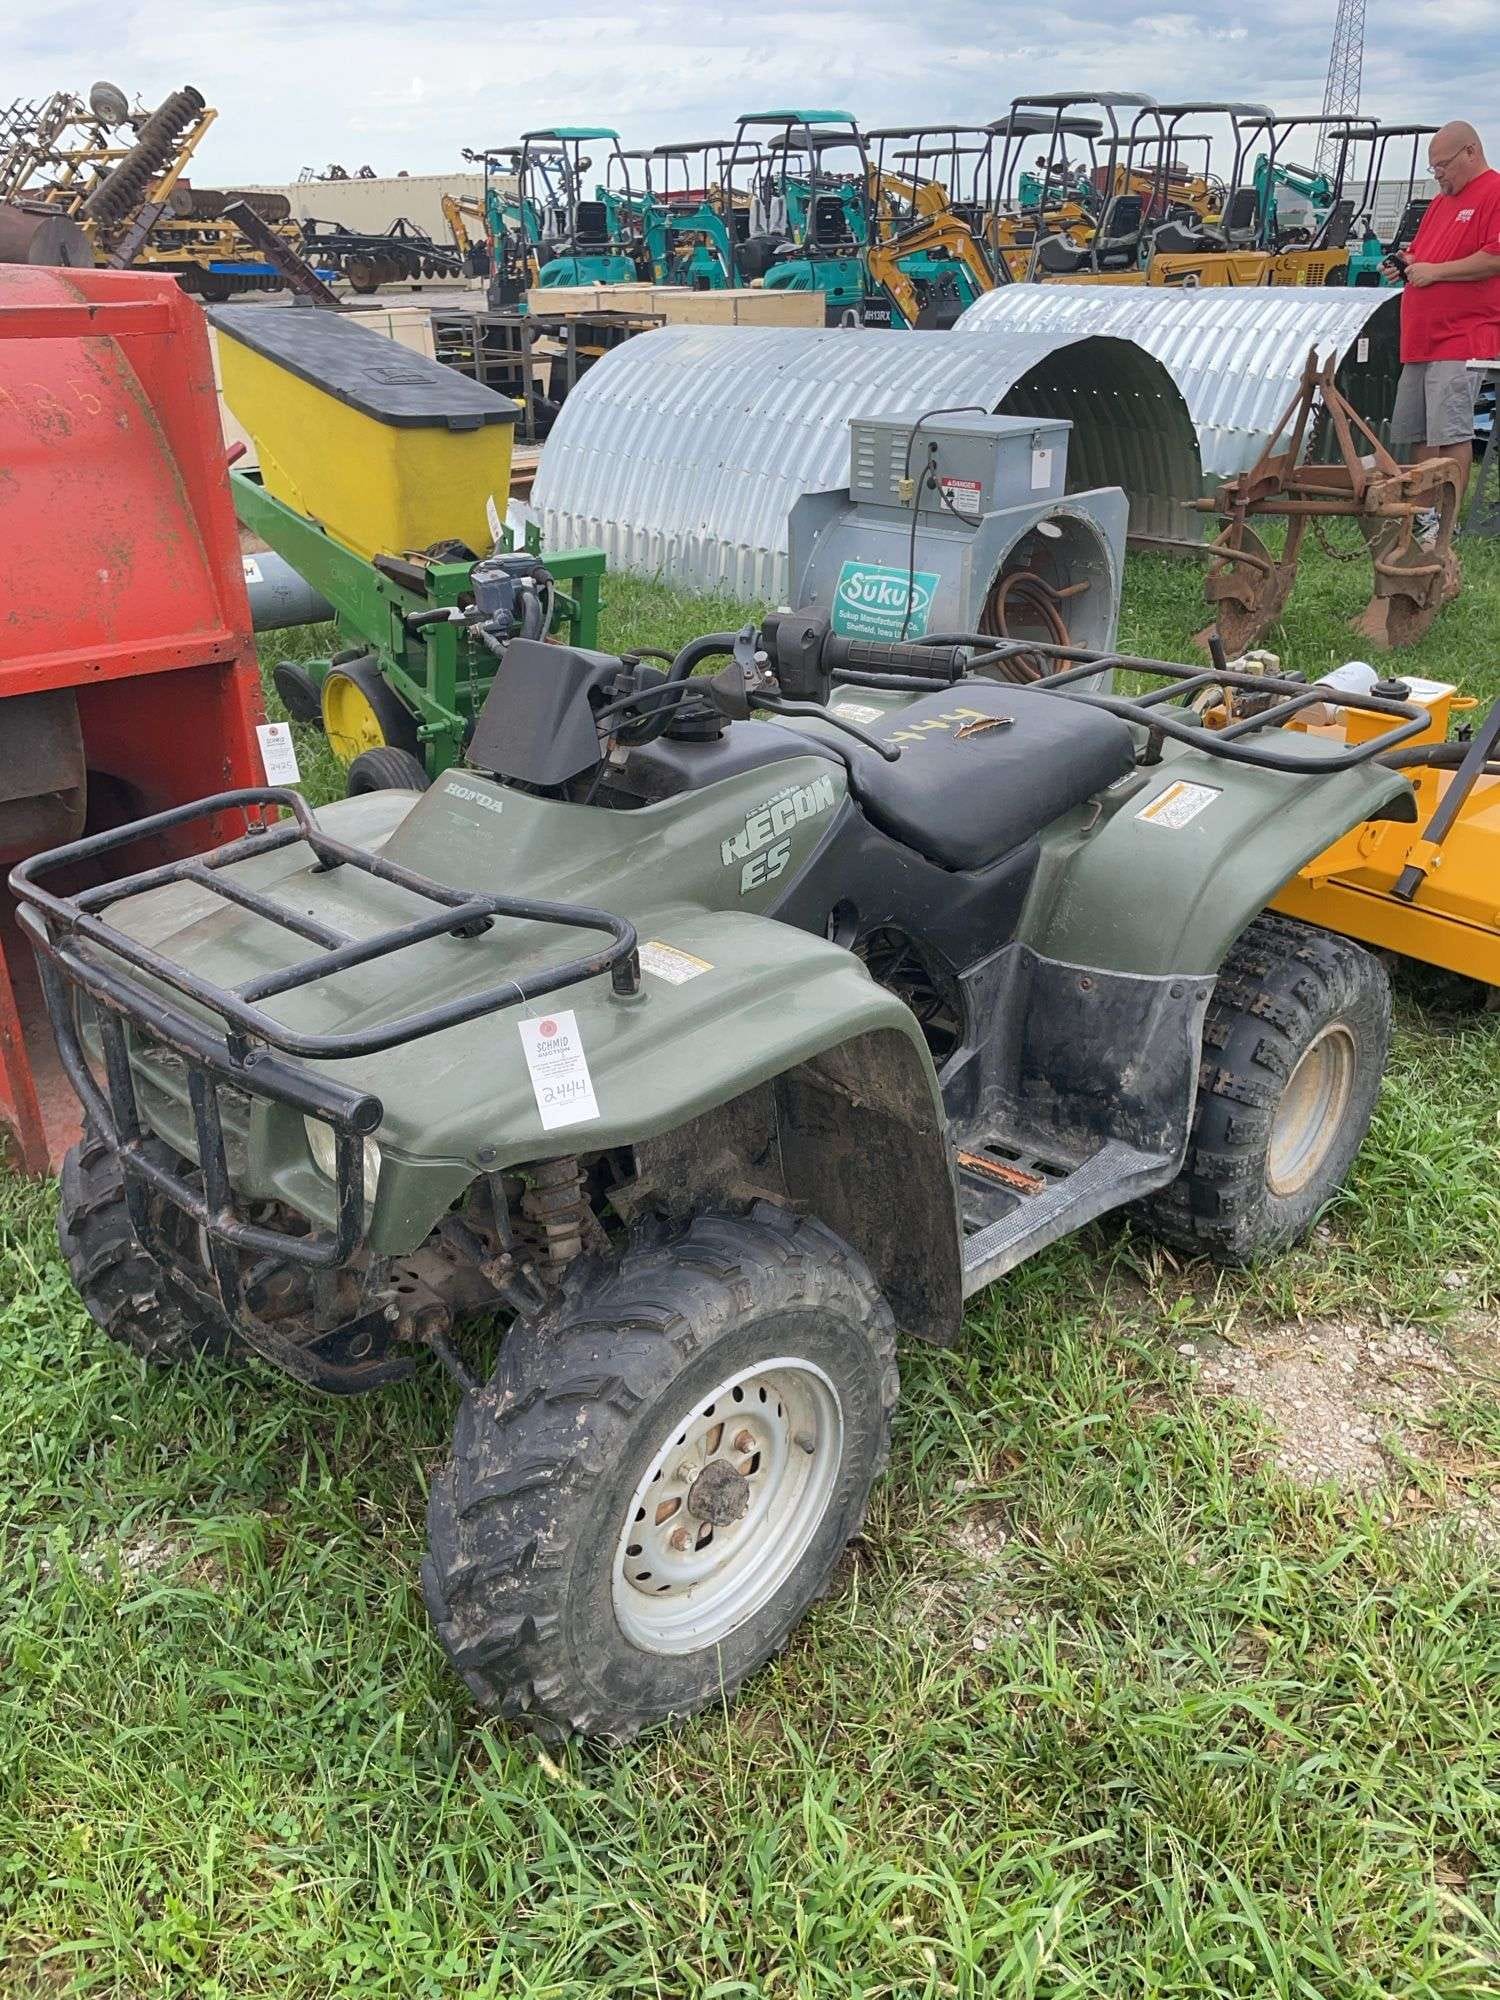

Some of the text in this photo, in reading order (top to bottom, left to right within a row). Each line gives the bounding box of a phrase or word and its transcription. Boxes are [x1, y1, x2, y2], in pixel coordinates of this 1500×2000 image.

[847, 571, 920, 615] Sukup
[838, 609, 860, 622] Sukup
[444, 782, 504, 814] HONDA
[720, 774, 835, 866] RECON
[741, 836, 791, 896] ES
[536, 1036, 569, 1053] SCHMID
[537, 1046, 571, 1058] AUCTION
[542, 1079, 587, 1103] 2444
